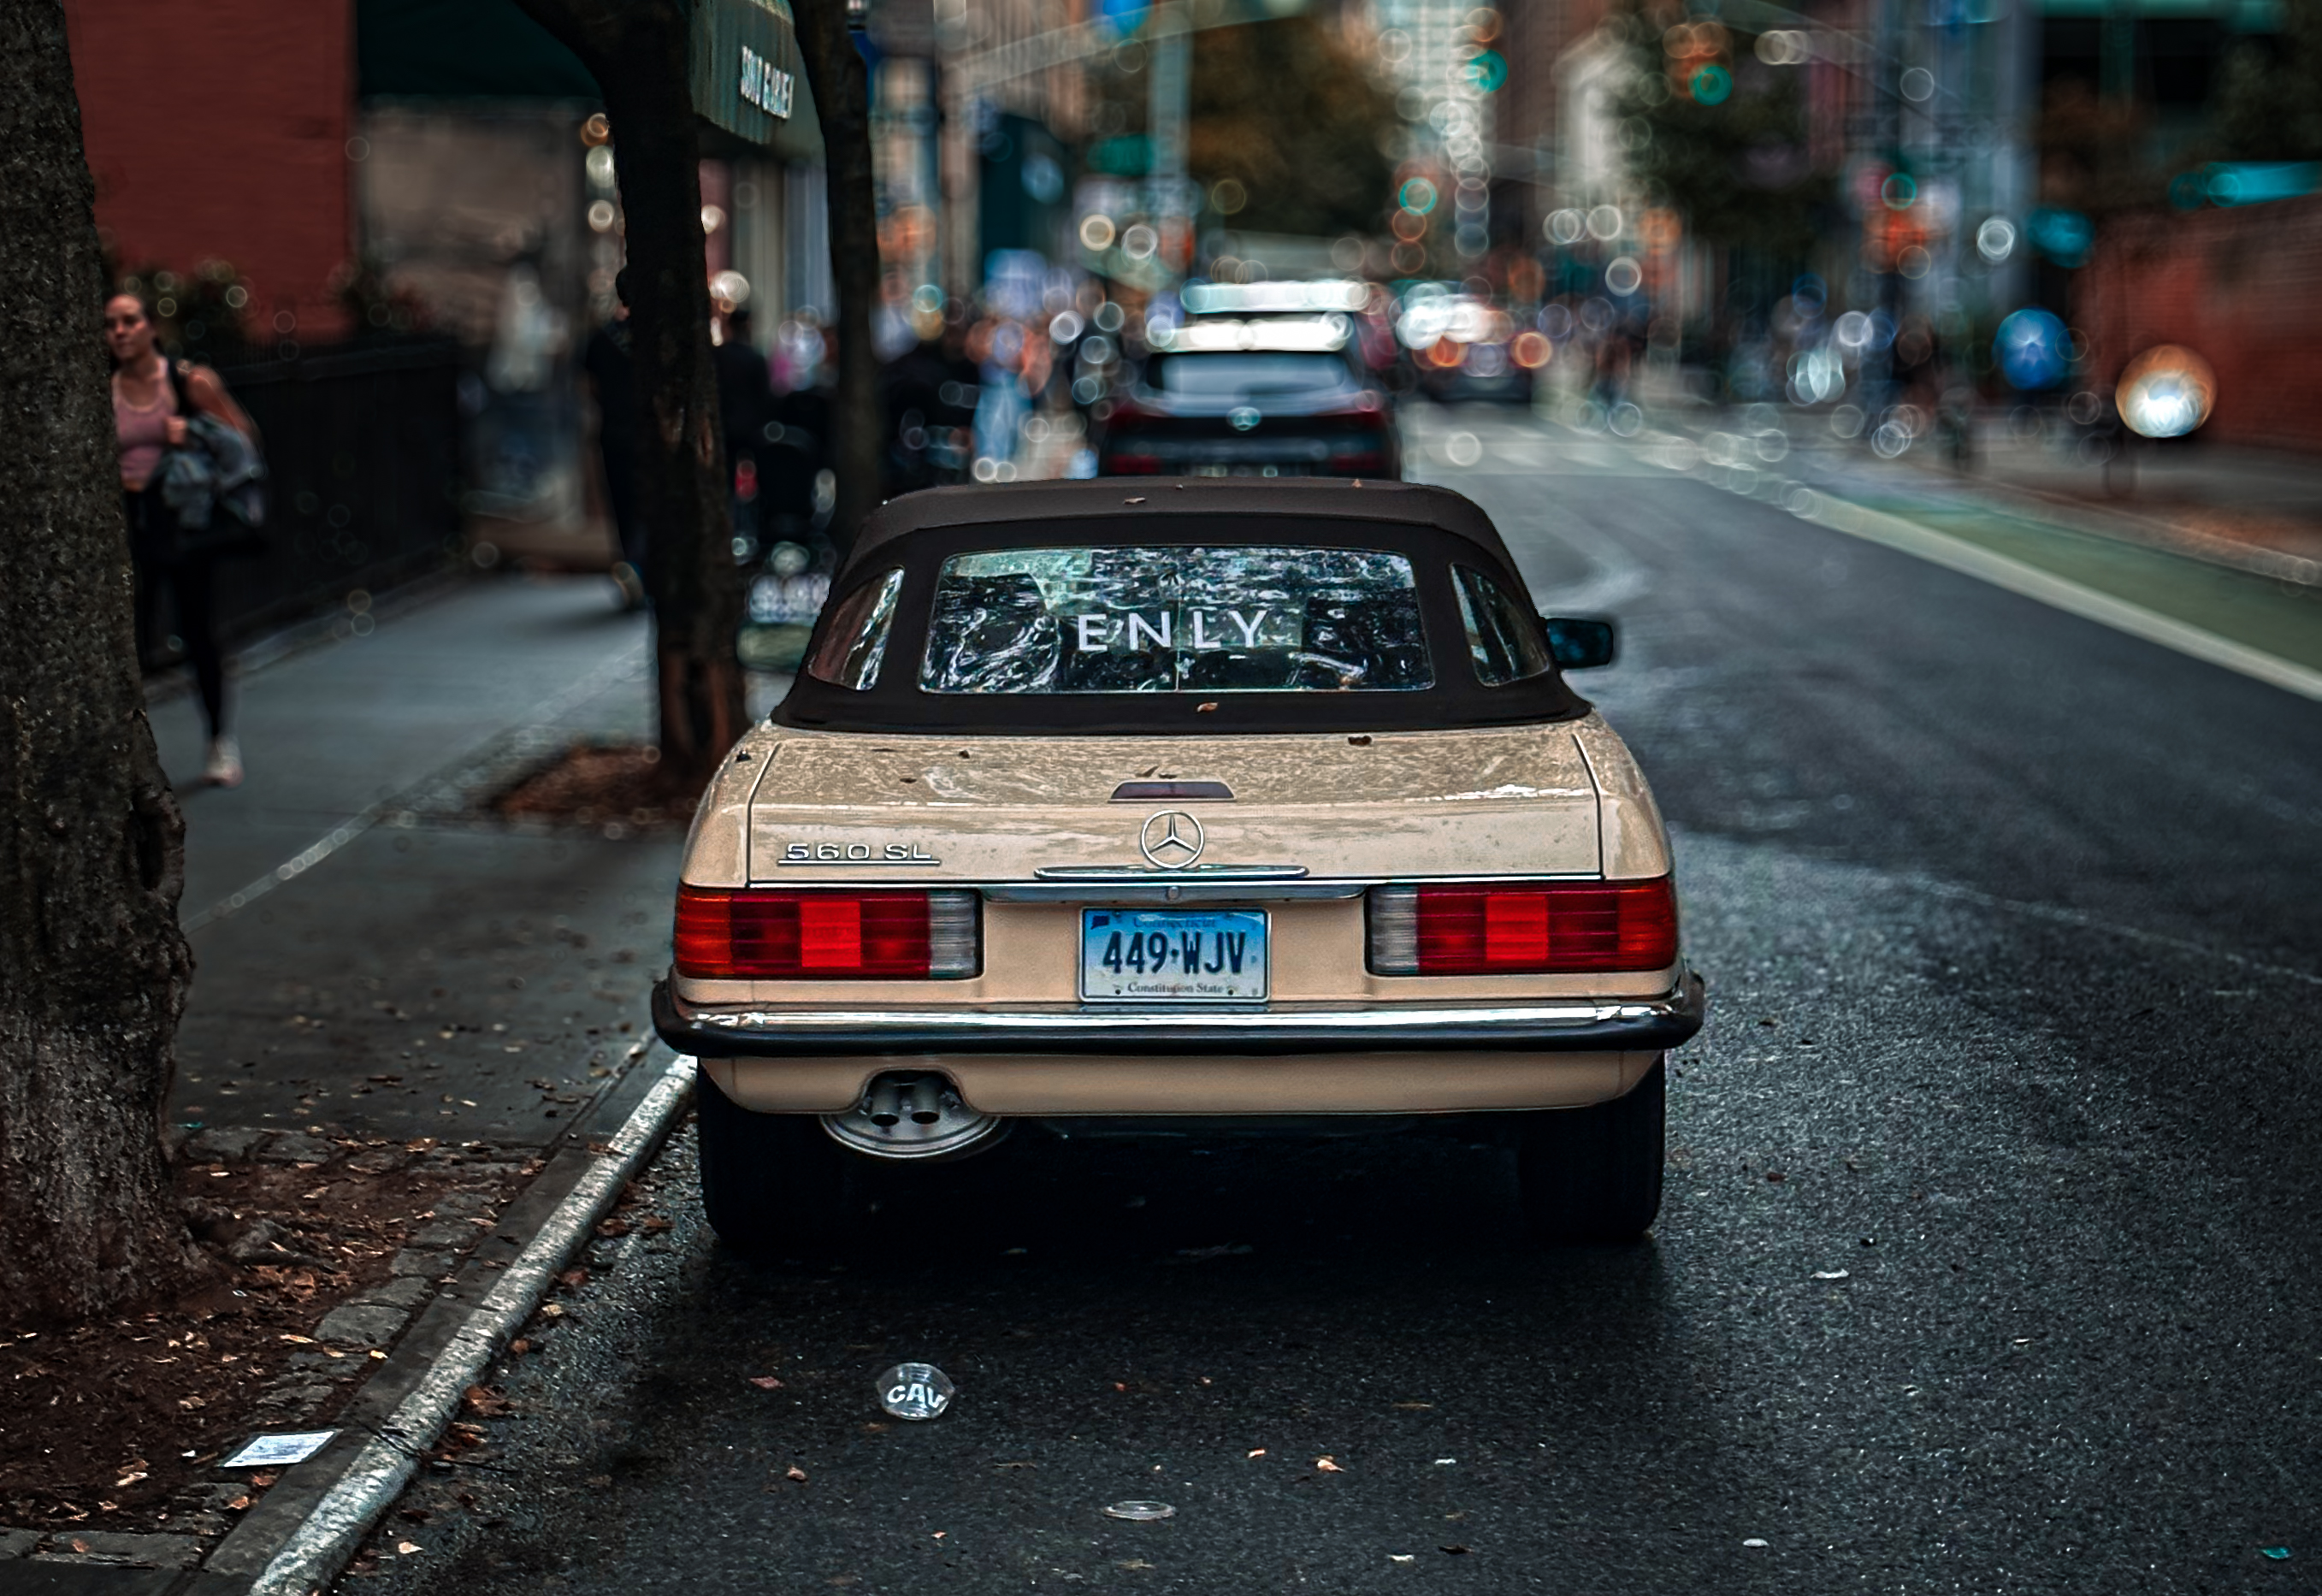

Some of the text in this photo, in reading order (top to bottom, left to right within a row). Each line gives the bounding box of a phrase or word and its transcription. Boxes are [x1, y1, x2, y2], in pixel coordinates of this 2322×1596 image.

[1078, 610, 1268, 652] ENLY
[786, 842, 932, 860] 560 SL
[1127, 981, 1225, 994] Constitution State
